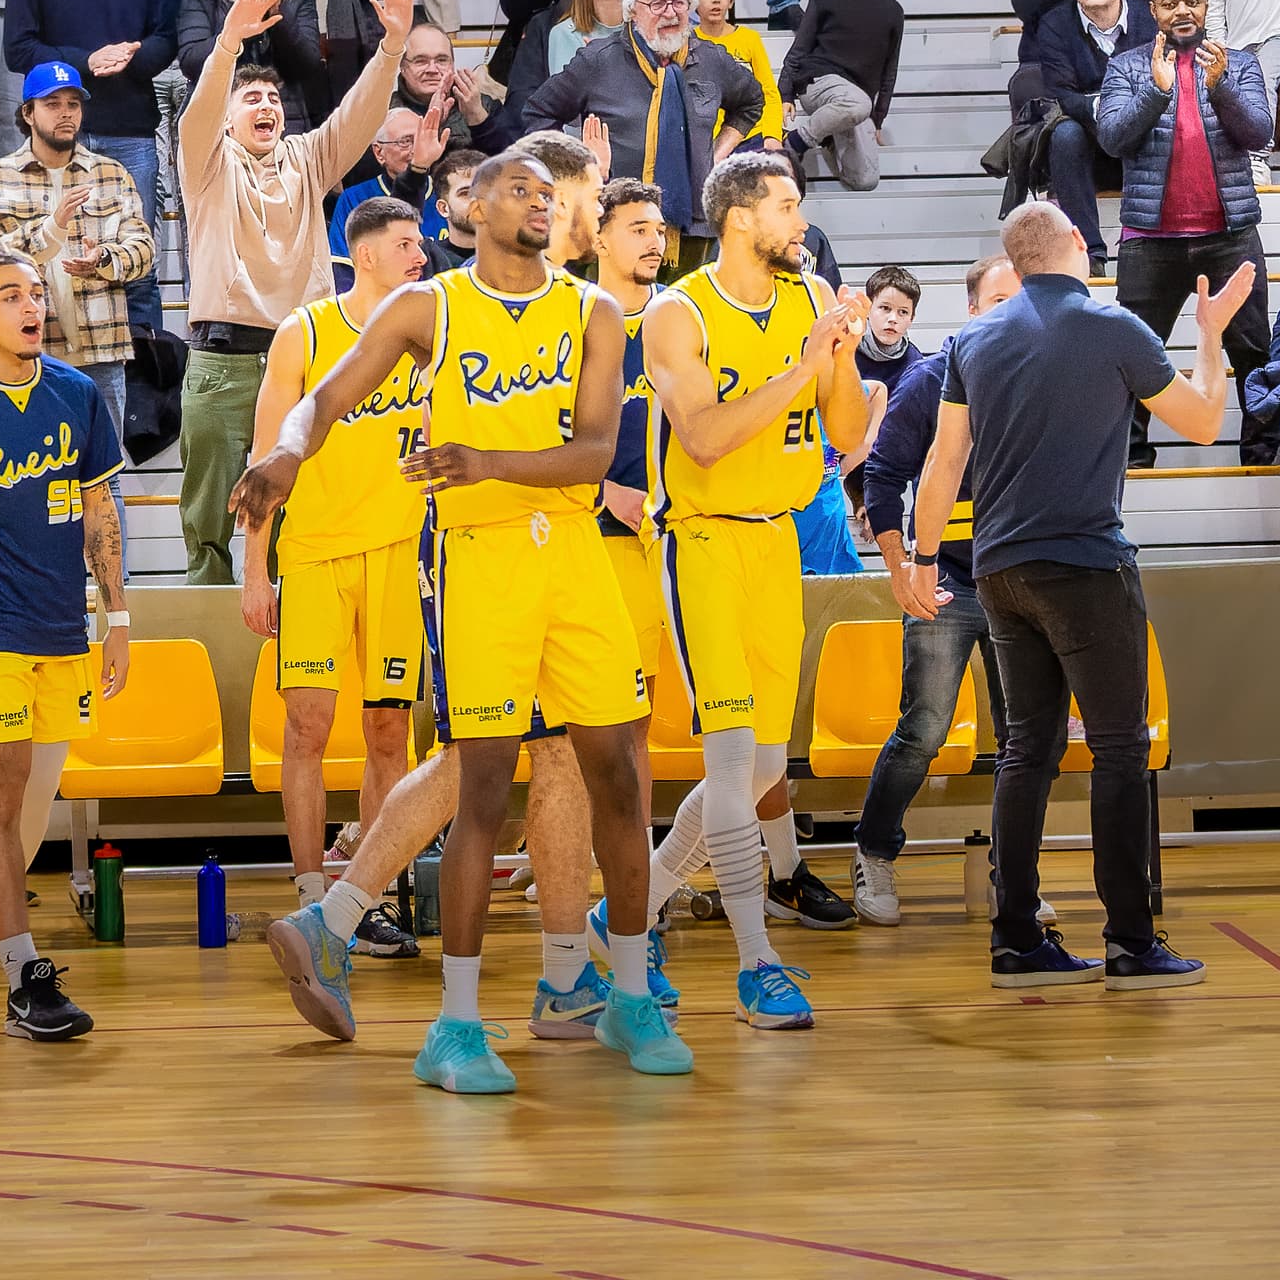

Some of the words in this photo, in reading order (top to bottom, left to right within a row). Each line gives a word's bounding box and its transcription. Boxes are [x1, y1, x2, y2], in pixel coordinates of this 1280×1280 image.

[52, 64, 70, 82] LA
[459, 331, 573, 407] Rueil
[337, 363, 432, 424] ueil
[284, 659, 326, 669] E.Leclerc
[304, 667, 325, 675] DRIVE
[383, 656, 408, 685] 16
[703, 698, 749, 710] E.Leclerc
[453, 705, 503, 716] E.Leclerc
[4, 718, 25, 728] DRIVE
[478, 714, 503, 722] DRIVE
